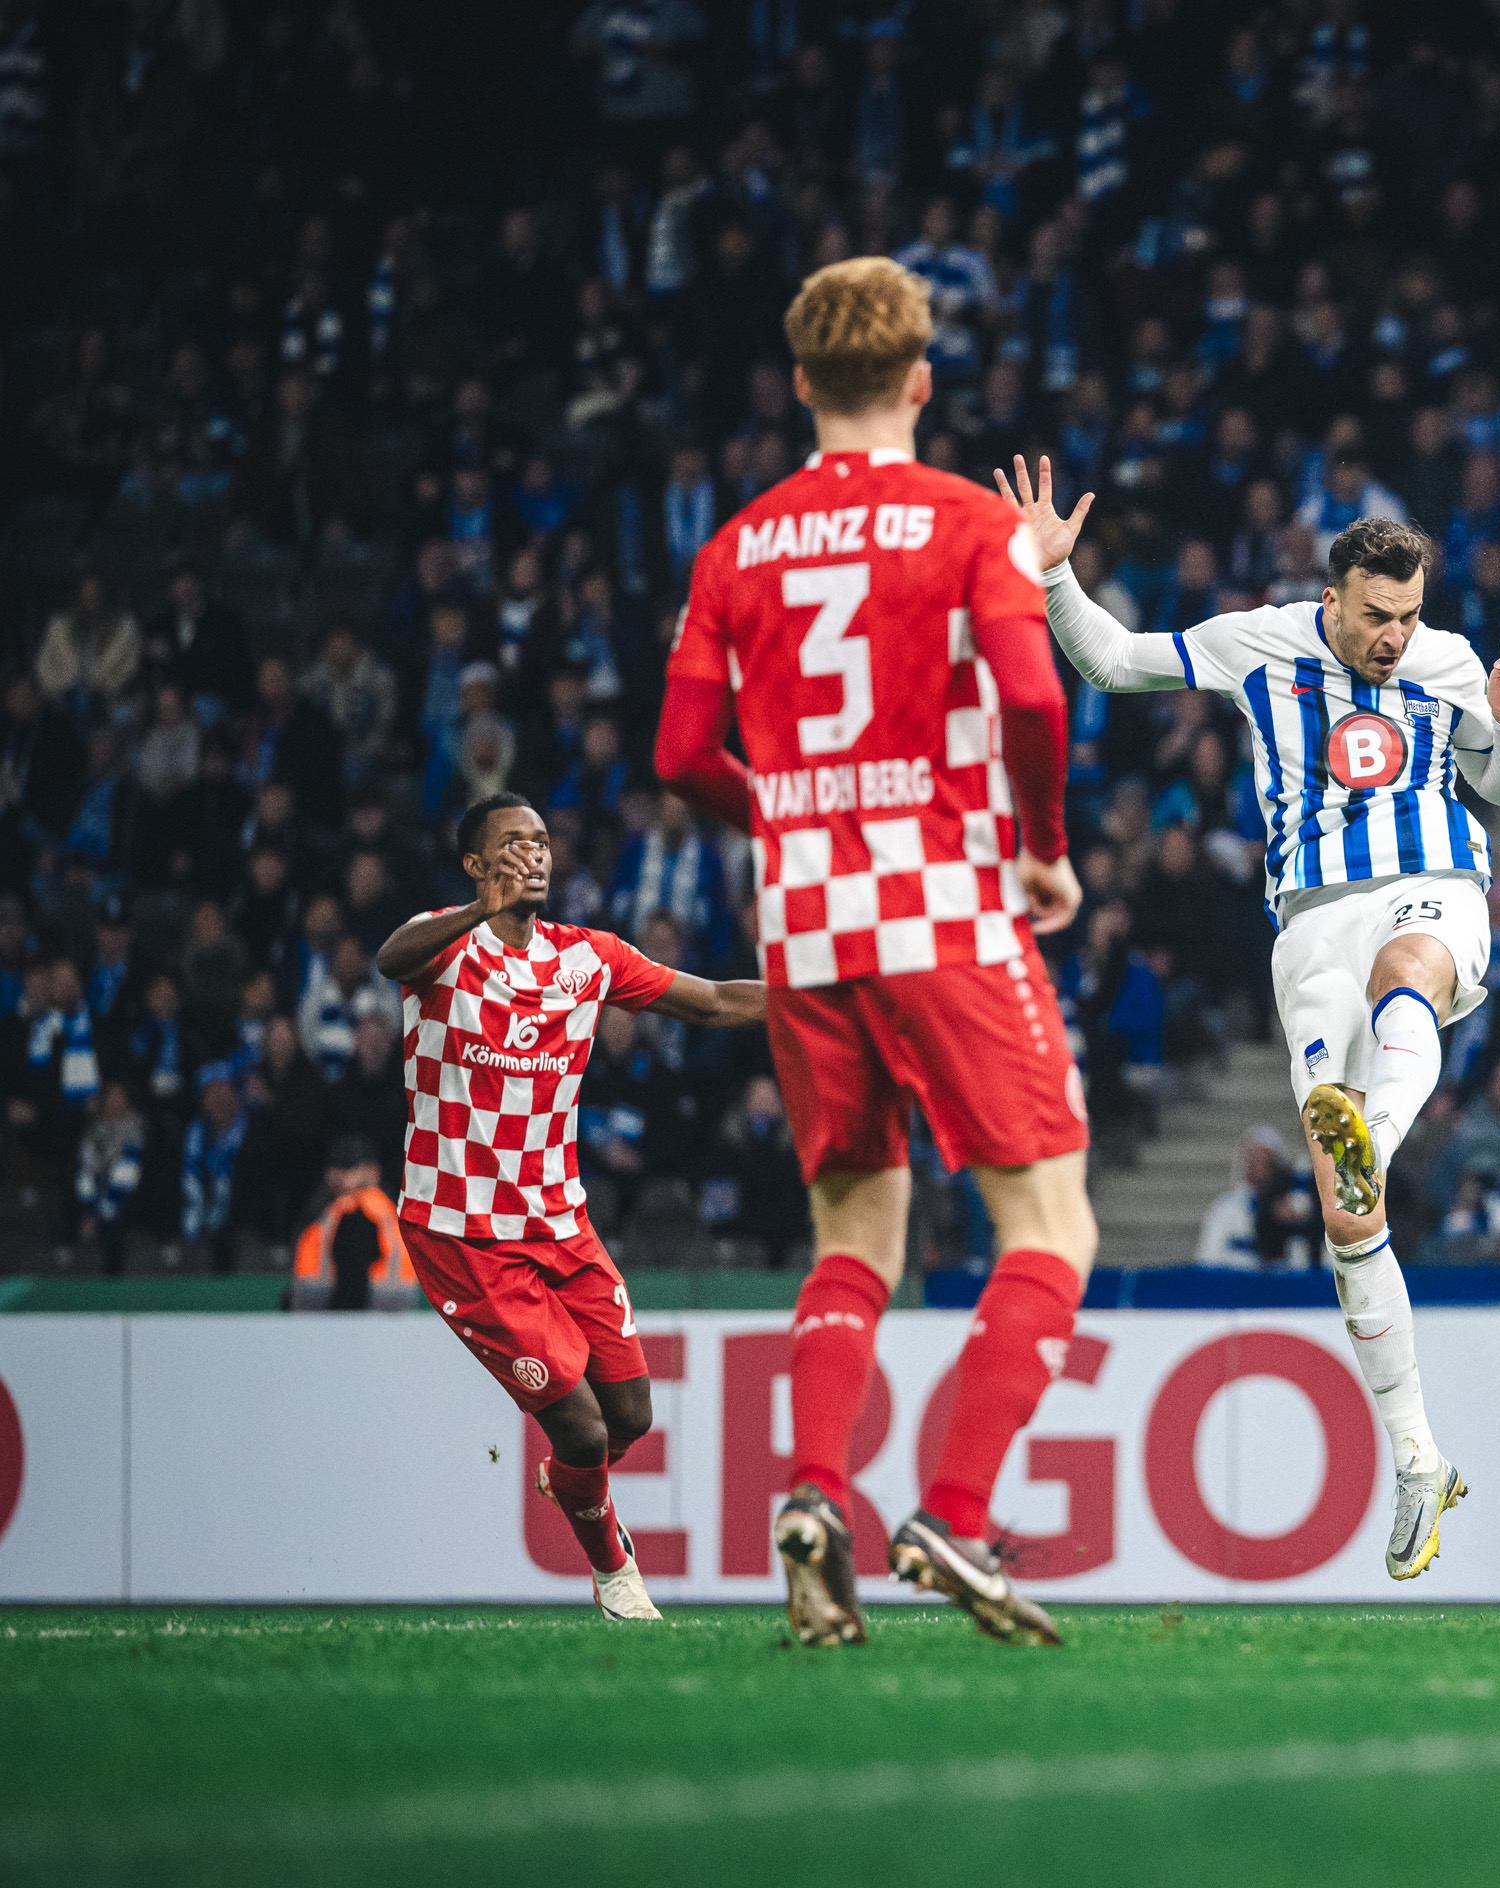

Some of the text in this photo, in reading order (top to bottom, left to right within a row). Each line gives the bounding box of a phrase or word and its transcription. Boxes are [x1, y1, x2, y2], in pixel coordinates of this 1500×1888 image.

[736, 504, 935, 569] MAINZ 05
[782, 562, 873, 756] 3
[1345, 728, 1387, 779] B
[753, 770, 814, 822] VAN
[858, 756, 935, 810] BERG
[1392, 901, 1443, 928] 25
[461, 1042, 571, 1075] Kömmerling
[521, 1327, 1379, 1583] ERGO
